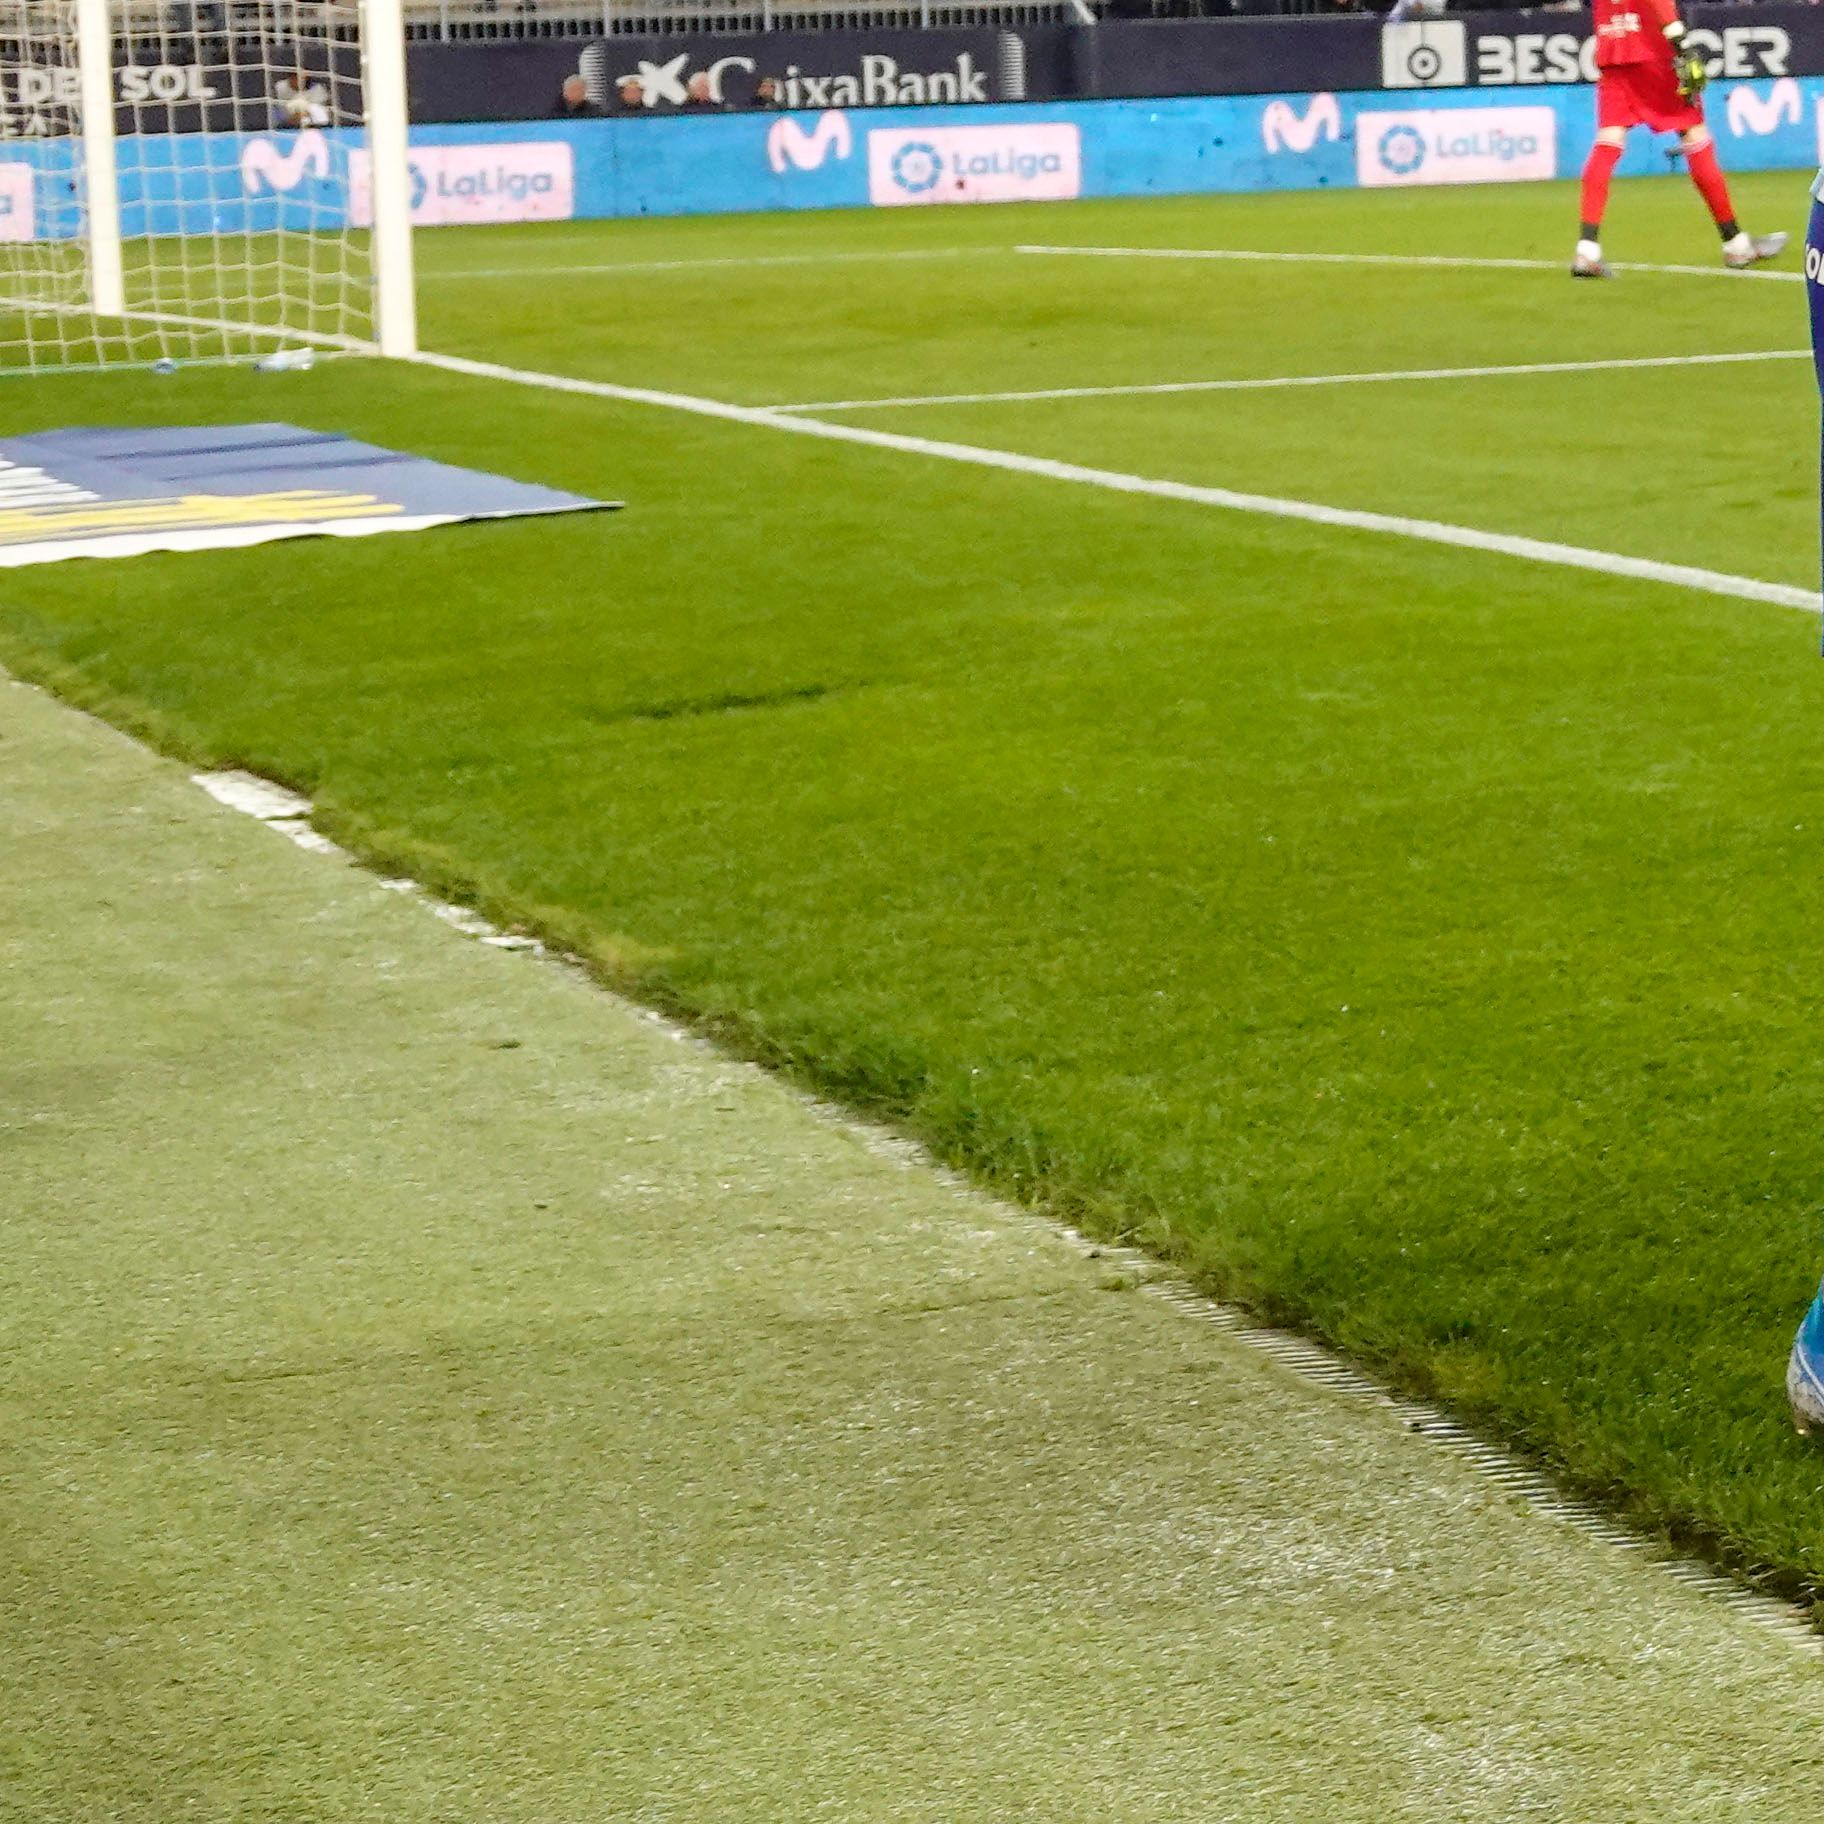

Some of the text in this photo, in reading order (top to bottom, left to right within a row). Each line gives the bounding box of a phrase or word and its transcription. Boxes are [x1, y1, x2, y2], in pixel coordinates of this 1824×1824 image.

[18, 64, 217, 103] DE SOL
[1435, 127, 1537, 161] LaLiga
[952, 147, 1062, 180] LaLiga
[436, 166, 554, 201] LaLiga
